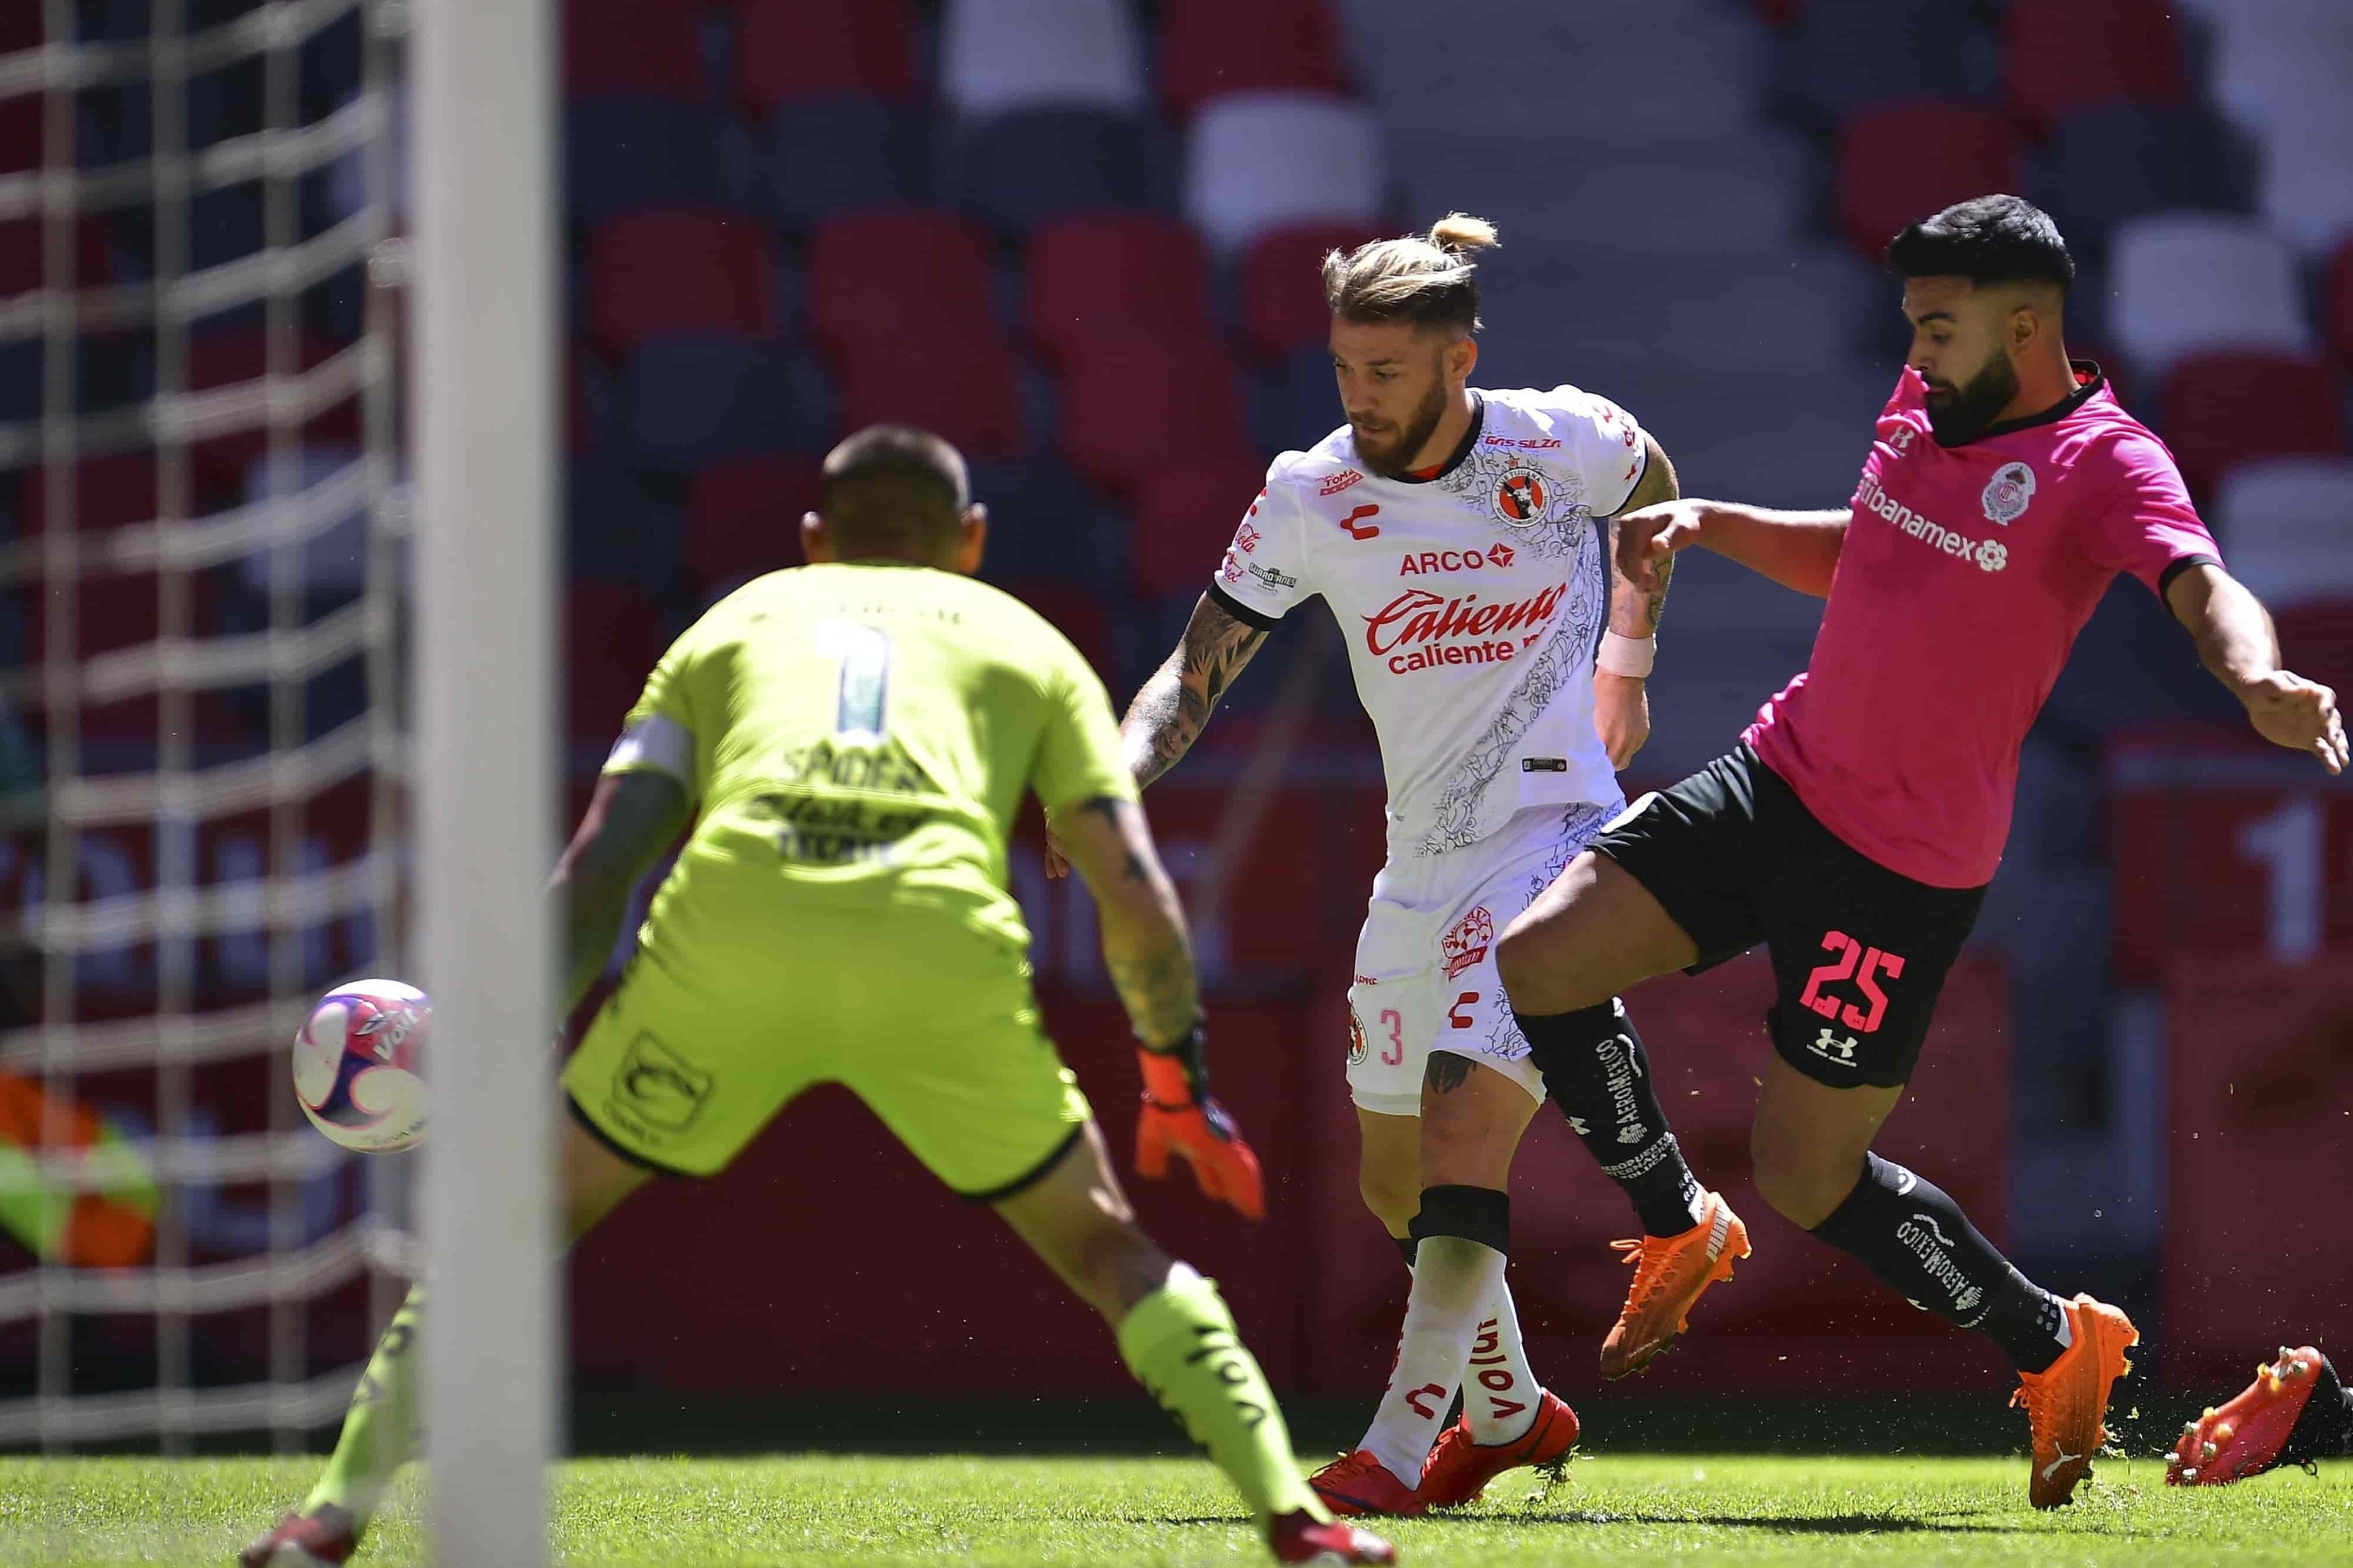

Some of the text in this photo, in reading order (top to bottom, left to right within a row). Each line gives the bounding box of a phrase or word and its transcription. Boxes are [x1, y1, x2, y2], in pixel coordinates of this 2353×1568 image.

[1485, 436, 1562, 448] GAS SILZA
[1399, 549, 1484, 576] ARCO
[1798, 930, 1907, 1034] 25
[1381, 1009, 1404, 1066] 3
